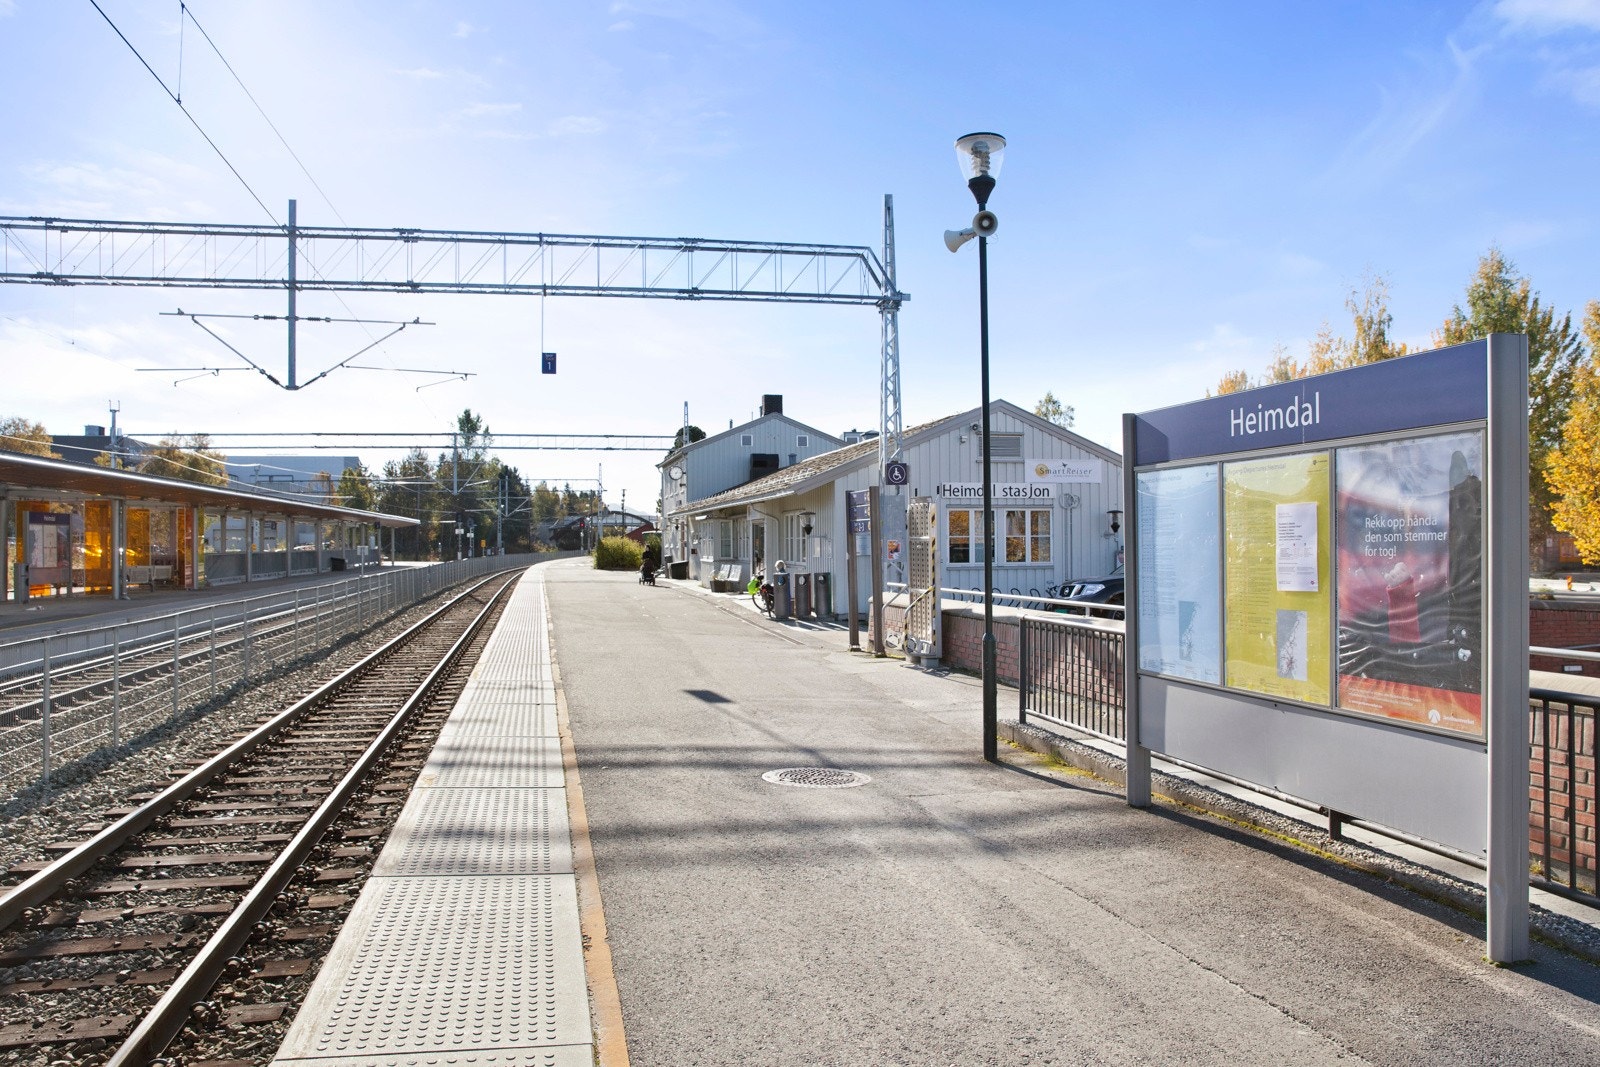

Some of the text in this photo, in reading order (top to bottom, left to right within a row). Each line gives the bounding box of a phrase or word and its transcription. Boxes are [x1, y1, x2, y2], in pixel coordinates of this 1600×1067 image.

[1230, 391, 1320, 437] Heimdal
[942, 484, 1050, 498] Heimdl stasjon
[1365, 515, 1437, 530] Rekk opp hånda
[1365, 531, 1447, 543] den som stemmer
[1365, 545, 1397, 559] for tog!
